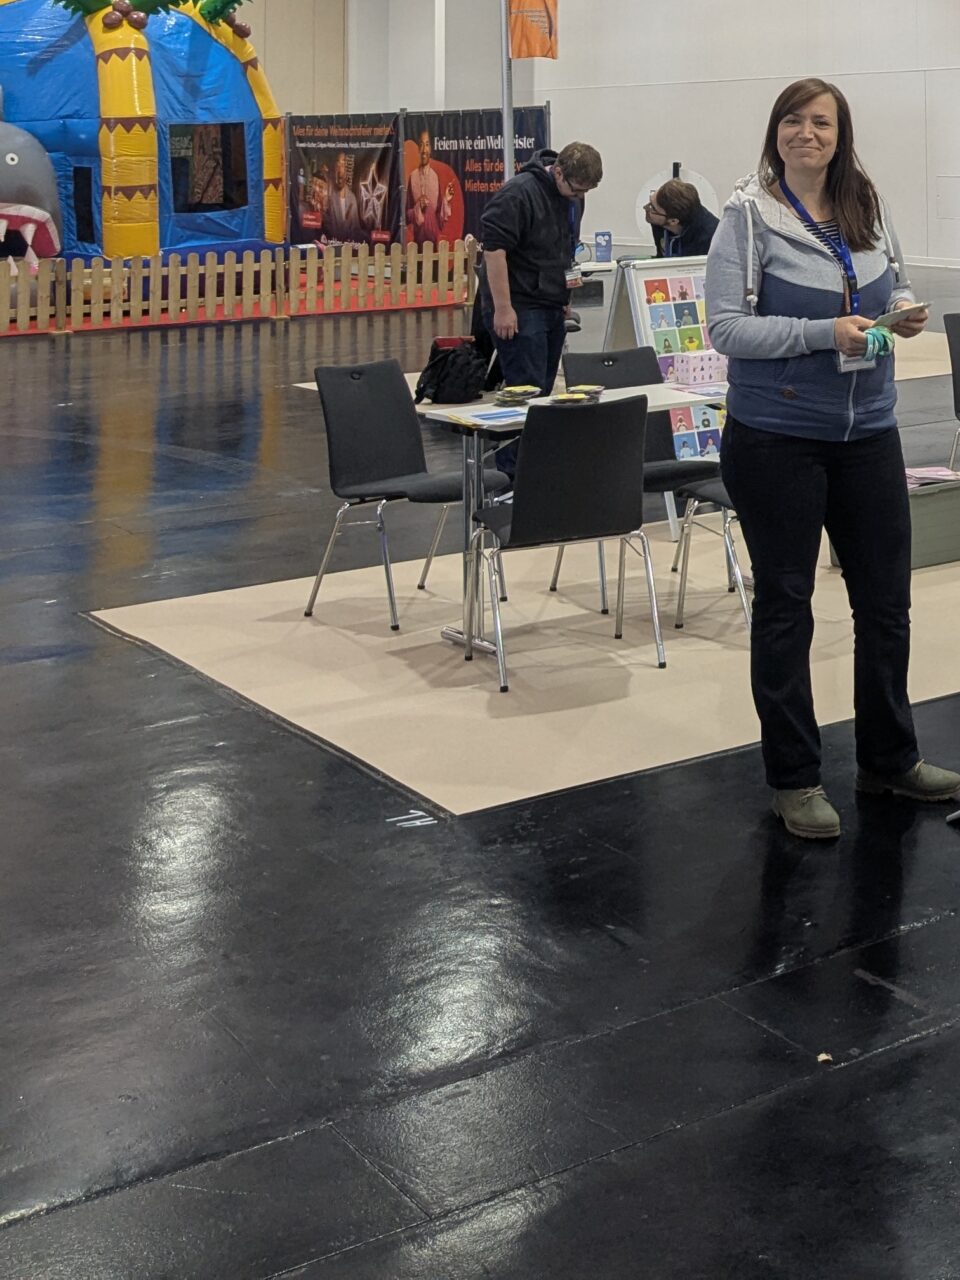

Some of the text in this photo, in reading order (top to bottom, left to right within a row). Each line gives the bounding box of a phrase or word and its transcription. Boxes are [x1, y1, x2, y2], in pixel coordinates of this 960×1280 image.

[433, 136, 458, 151] Feiern
[459, 136, 473, 150] wie
[473, 135, 486, 150] ein
[465, 159, 482, 172] Alles
[483, 158, 493, 172] für
[465, 180, 489, 192] Mieten
